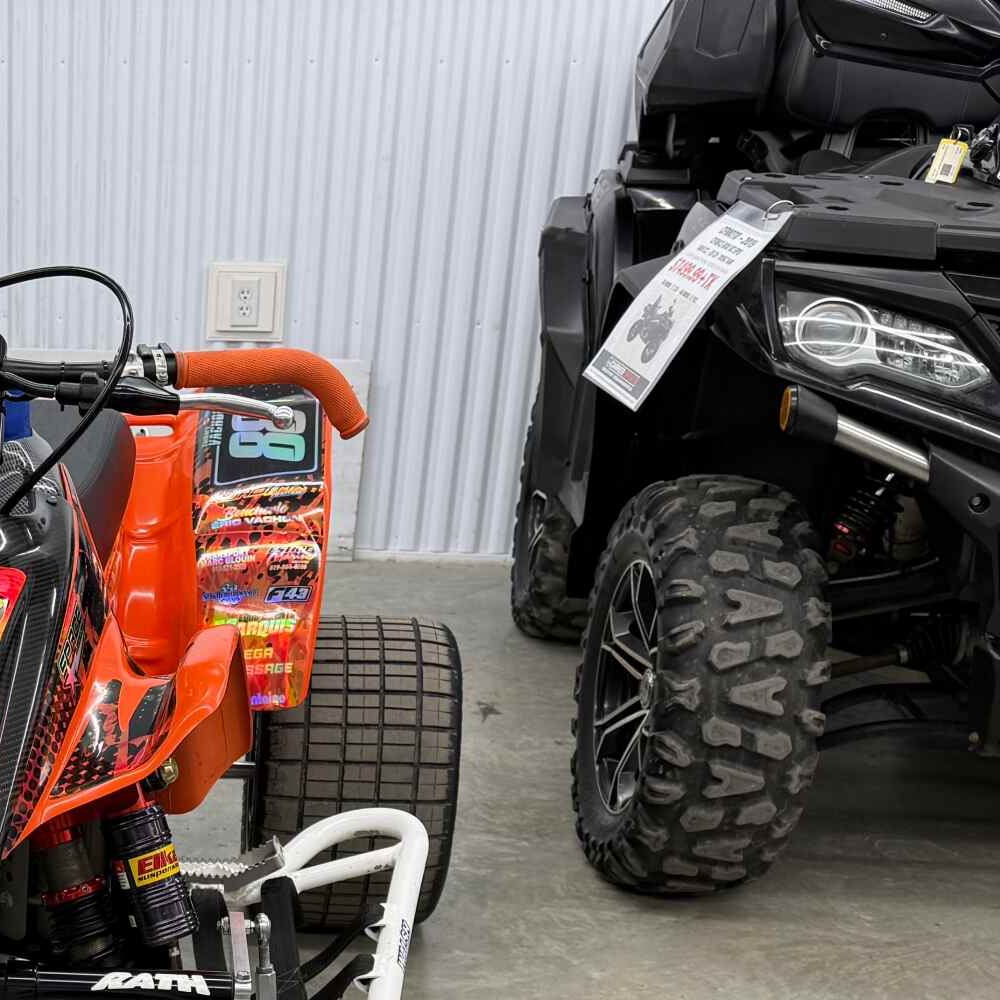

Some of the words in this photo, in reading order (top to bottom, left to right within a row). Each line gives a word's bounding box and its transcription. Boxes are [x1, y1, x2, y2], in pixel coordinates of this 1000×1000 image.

[244, 647, 274, 660] EGA
[245, 662, 294, 676] SSAGE
[91, 972, 210, 996] RATH
